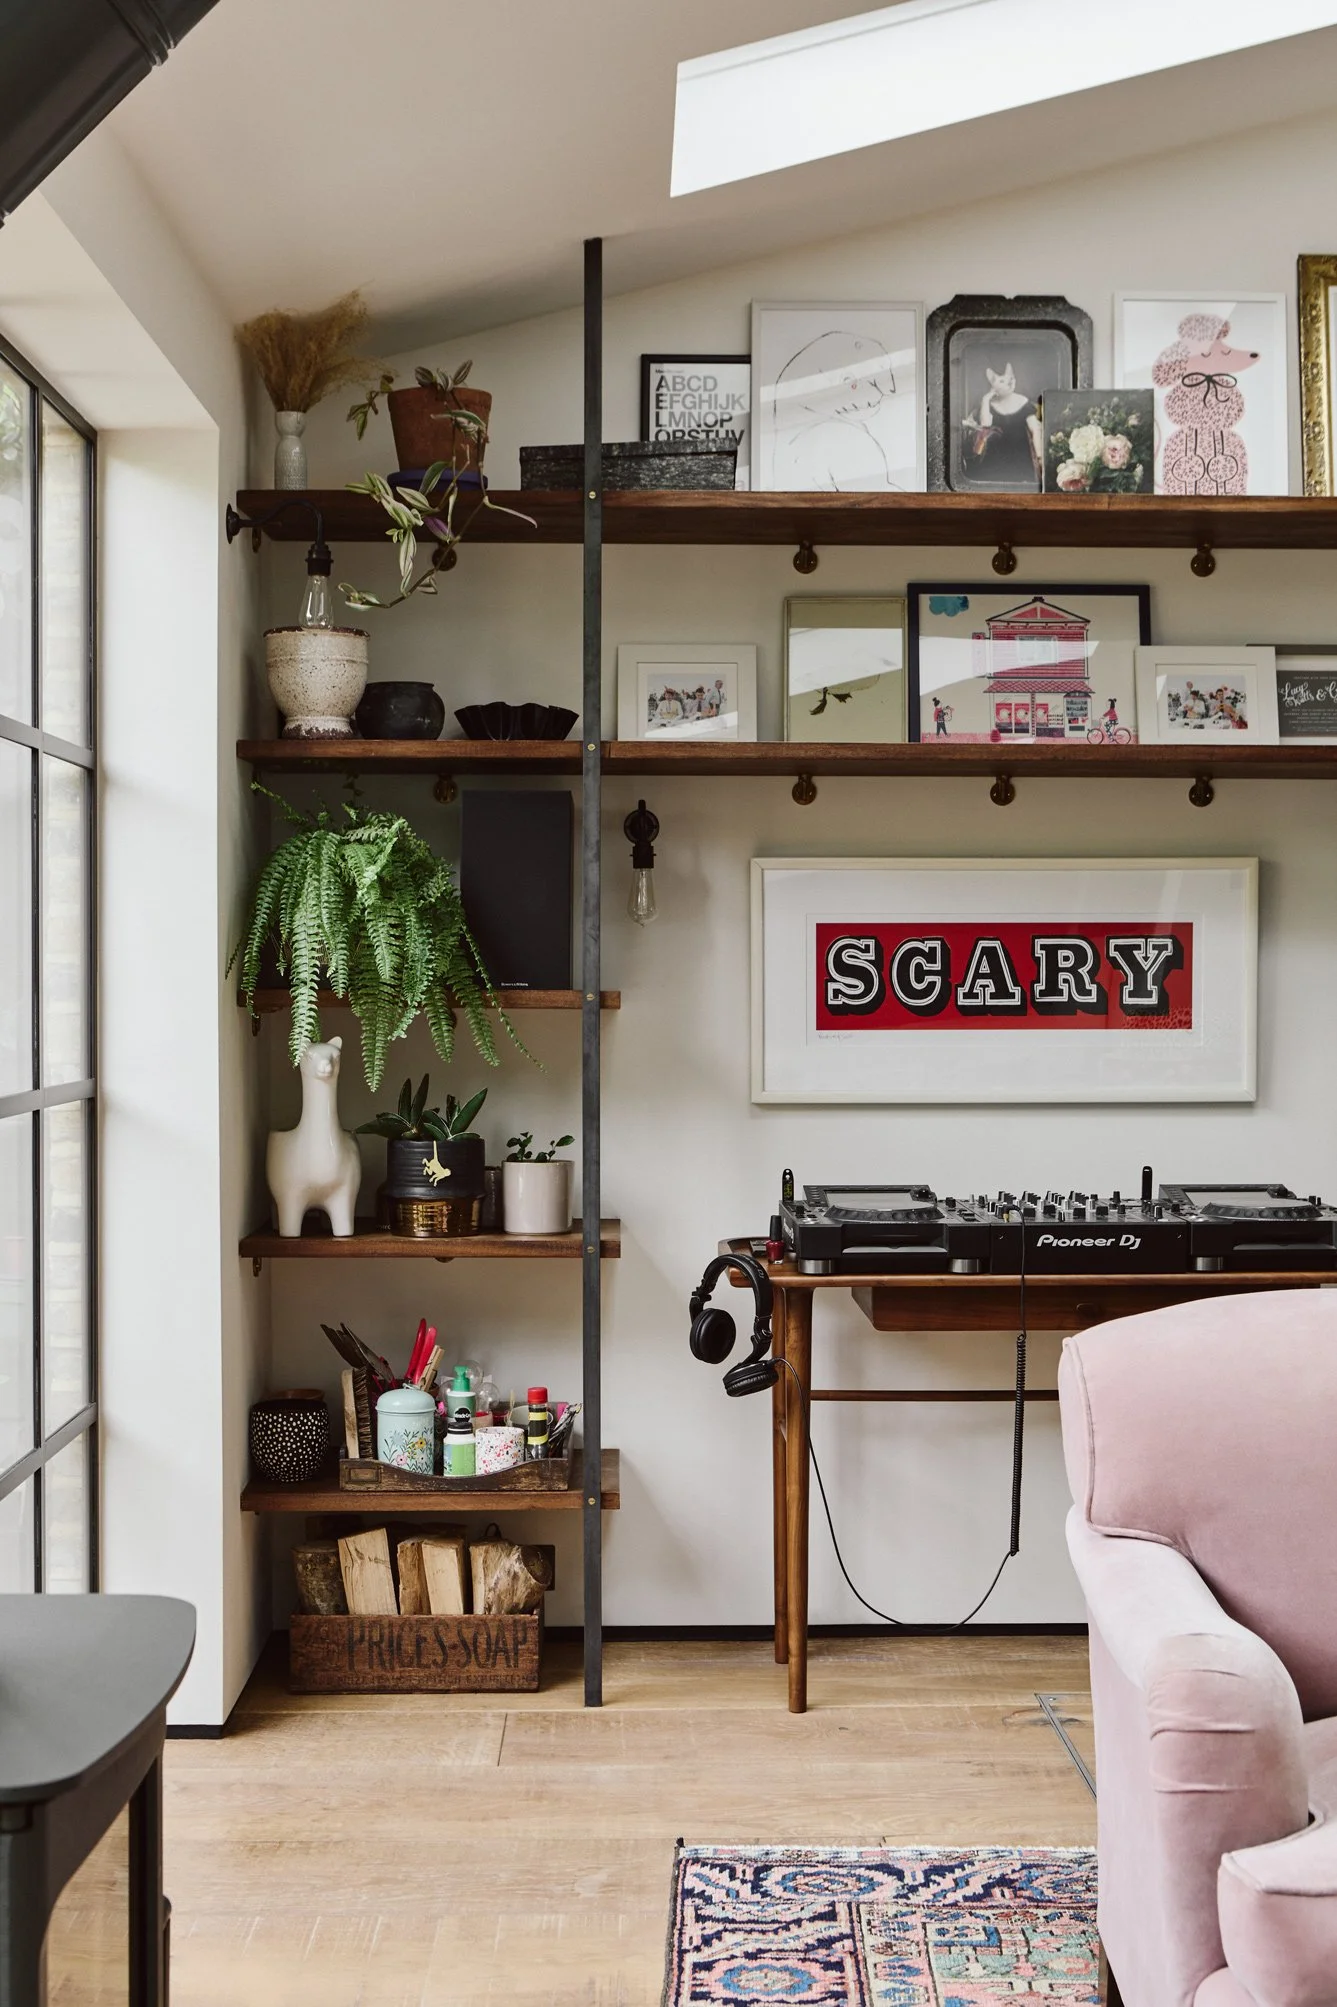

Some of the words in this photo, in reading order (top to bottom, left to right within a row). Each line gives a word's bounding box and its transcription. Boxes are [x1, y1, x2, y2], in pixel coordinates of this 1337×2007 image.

[656, 375, 718, 392] ABCD
[655, 393, 746, 410] EFGHIJK
[655, 411, 733, 428] LMNOP
[825, 935, 1184, 1017] SCARY
[1036, 1234, 1115, 1247] Pioneer
[456, 1618, 527, 1668] SOAP
